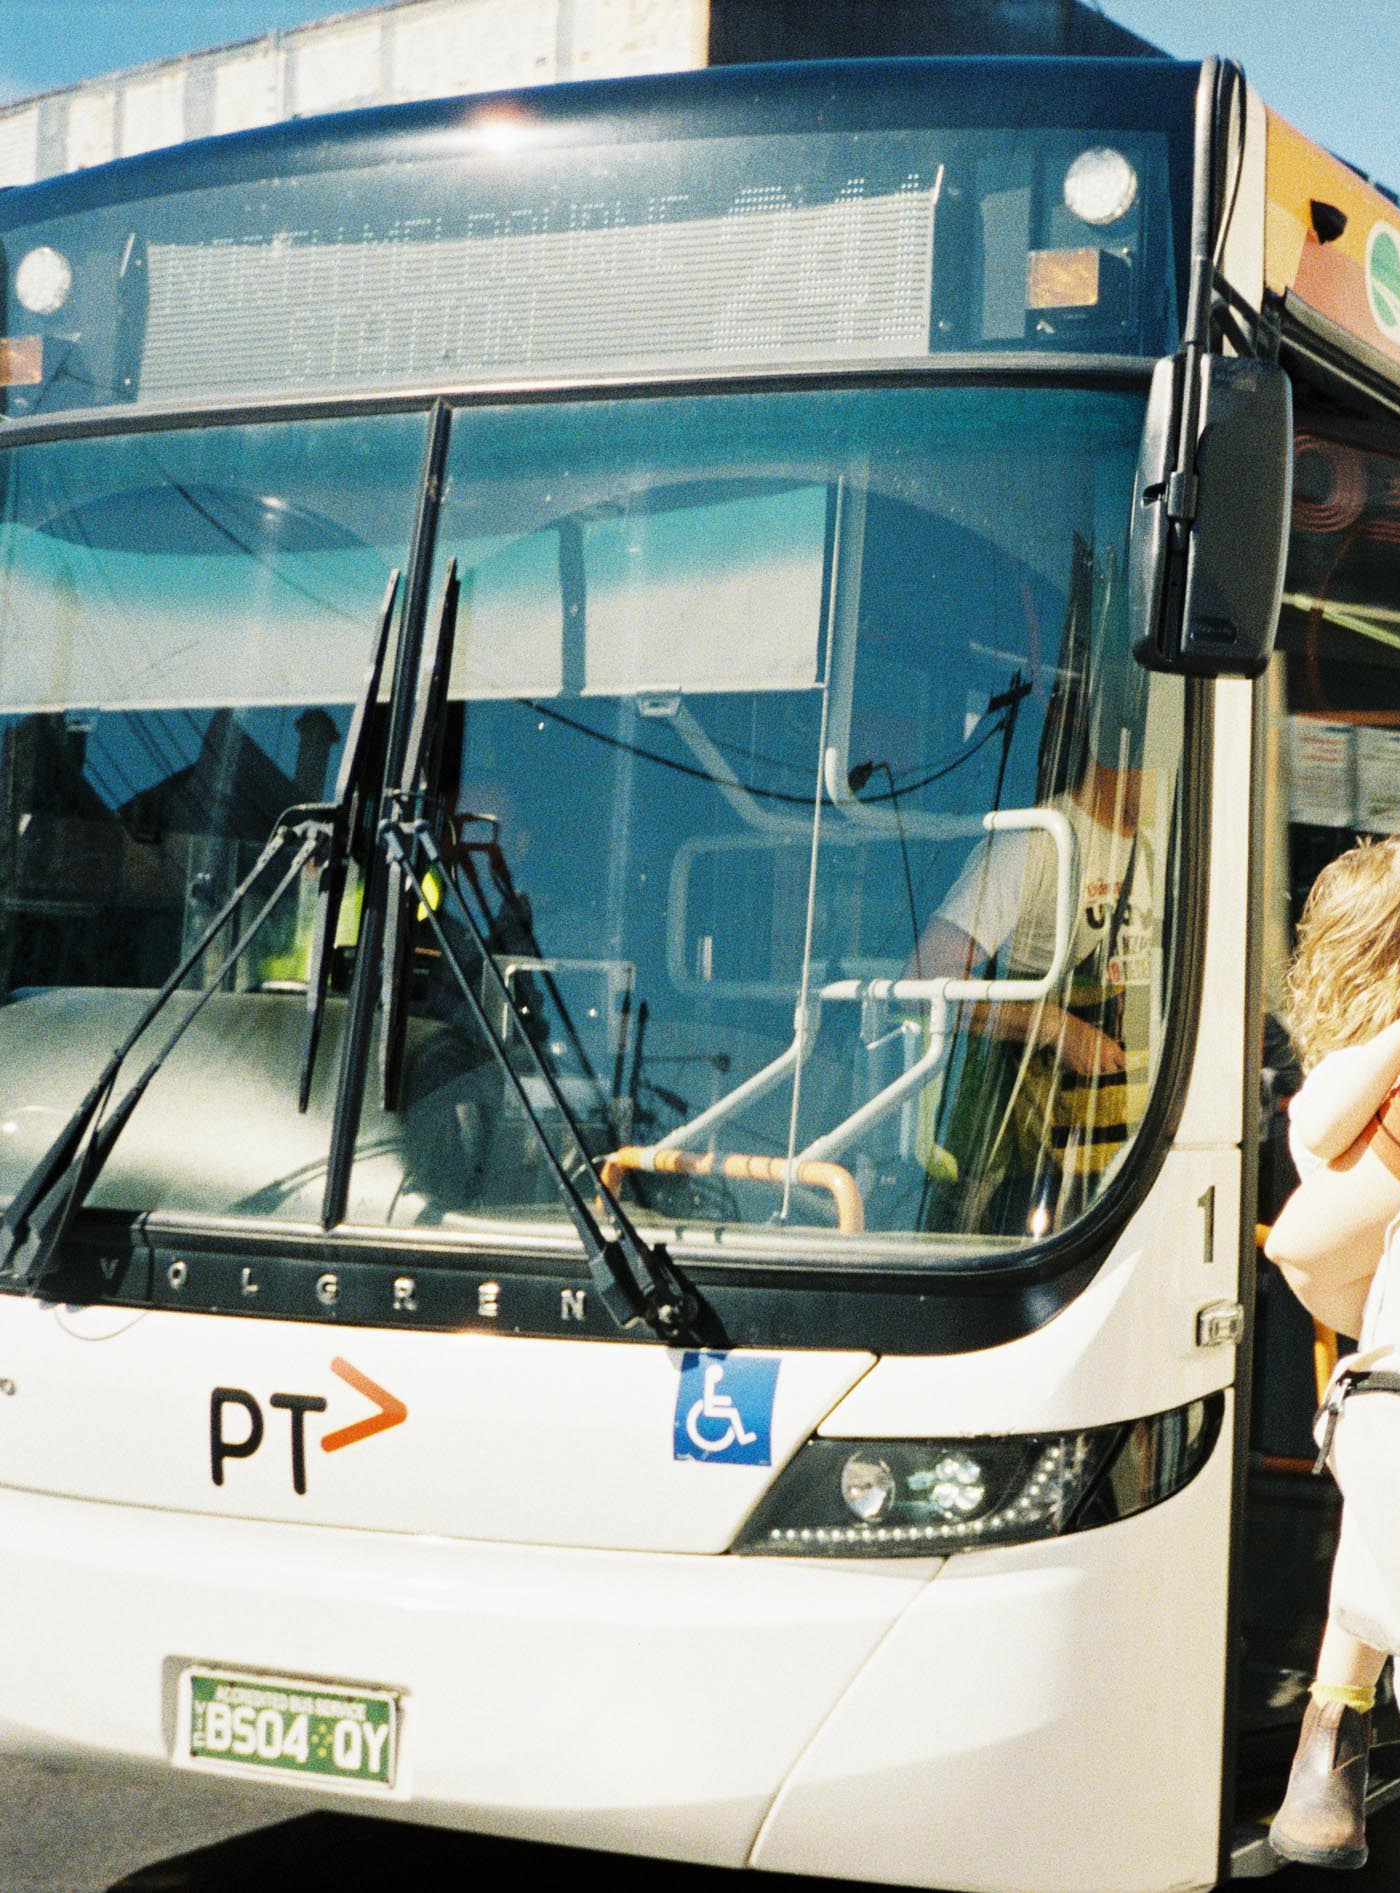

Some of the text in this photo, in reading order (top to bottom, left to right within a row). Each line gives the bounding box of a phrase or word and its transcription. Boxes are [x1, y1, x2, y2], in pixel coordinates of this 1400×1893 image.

[712, 173, 923, 351] 241
[1196, 1184, 1216, 1264] 1
[100, 1257, 587, 1321] VOLGREN
